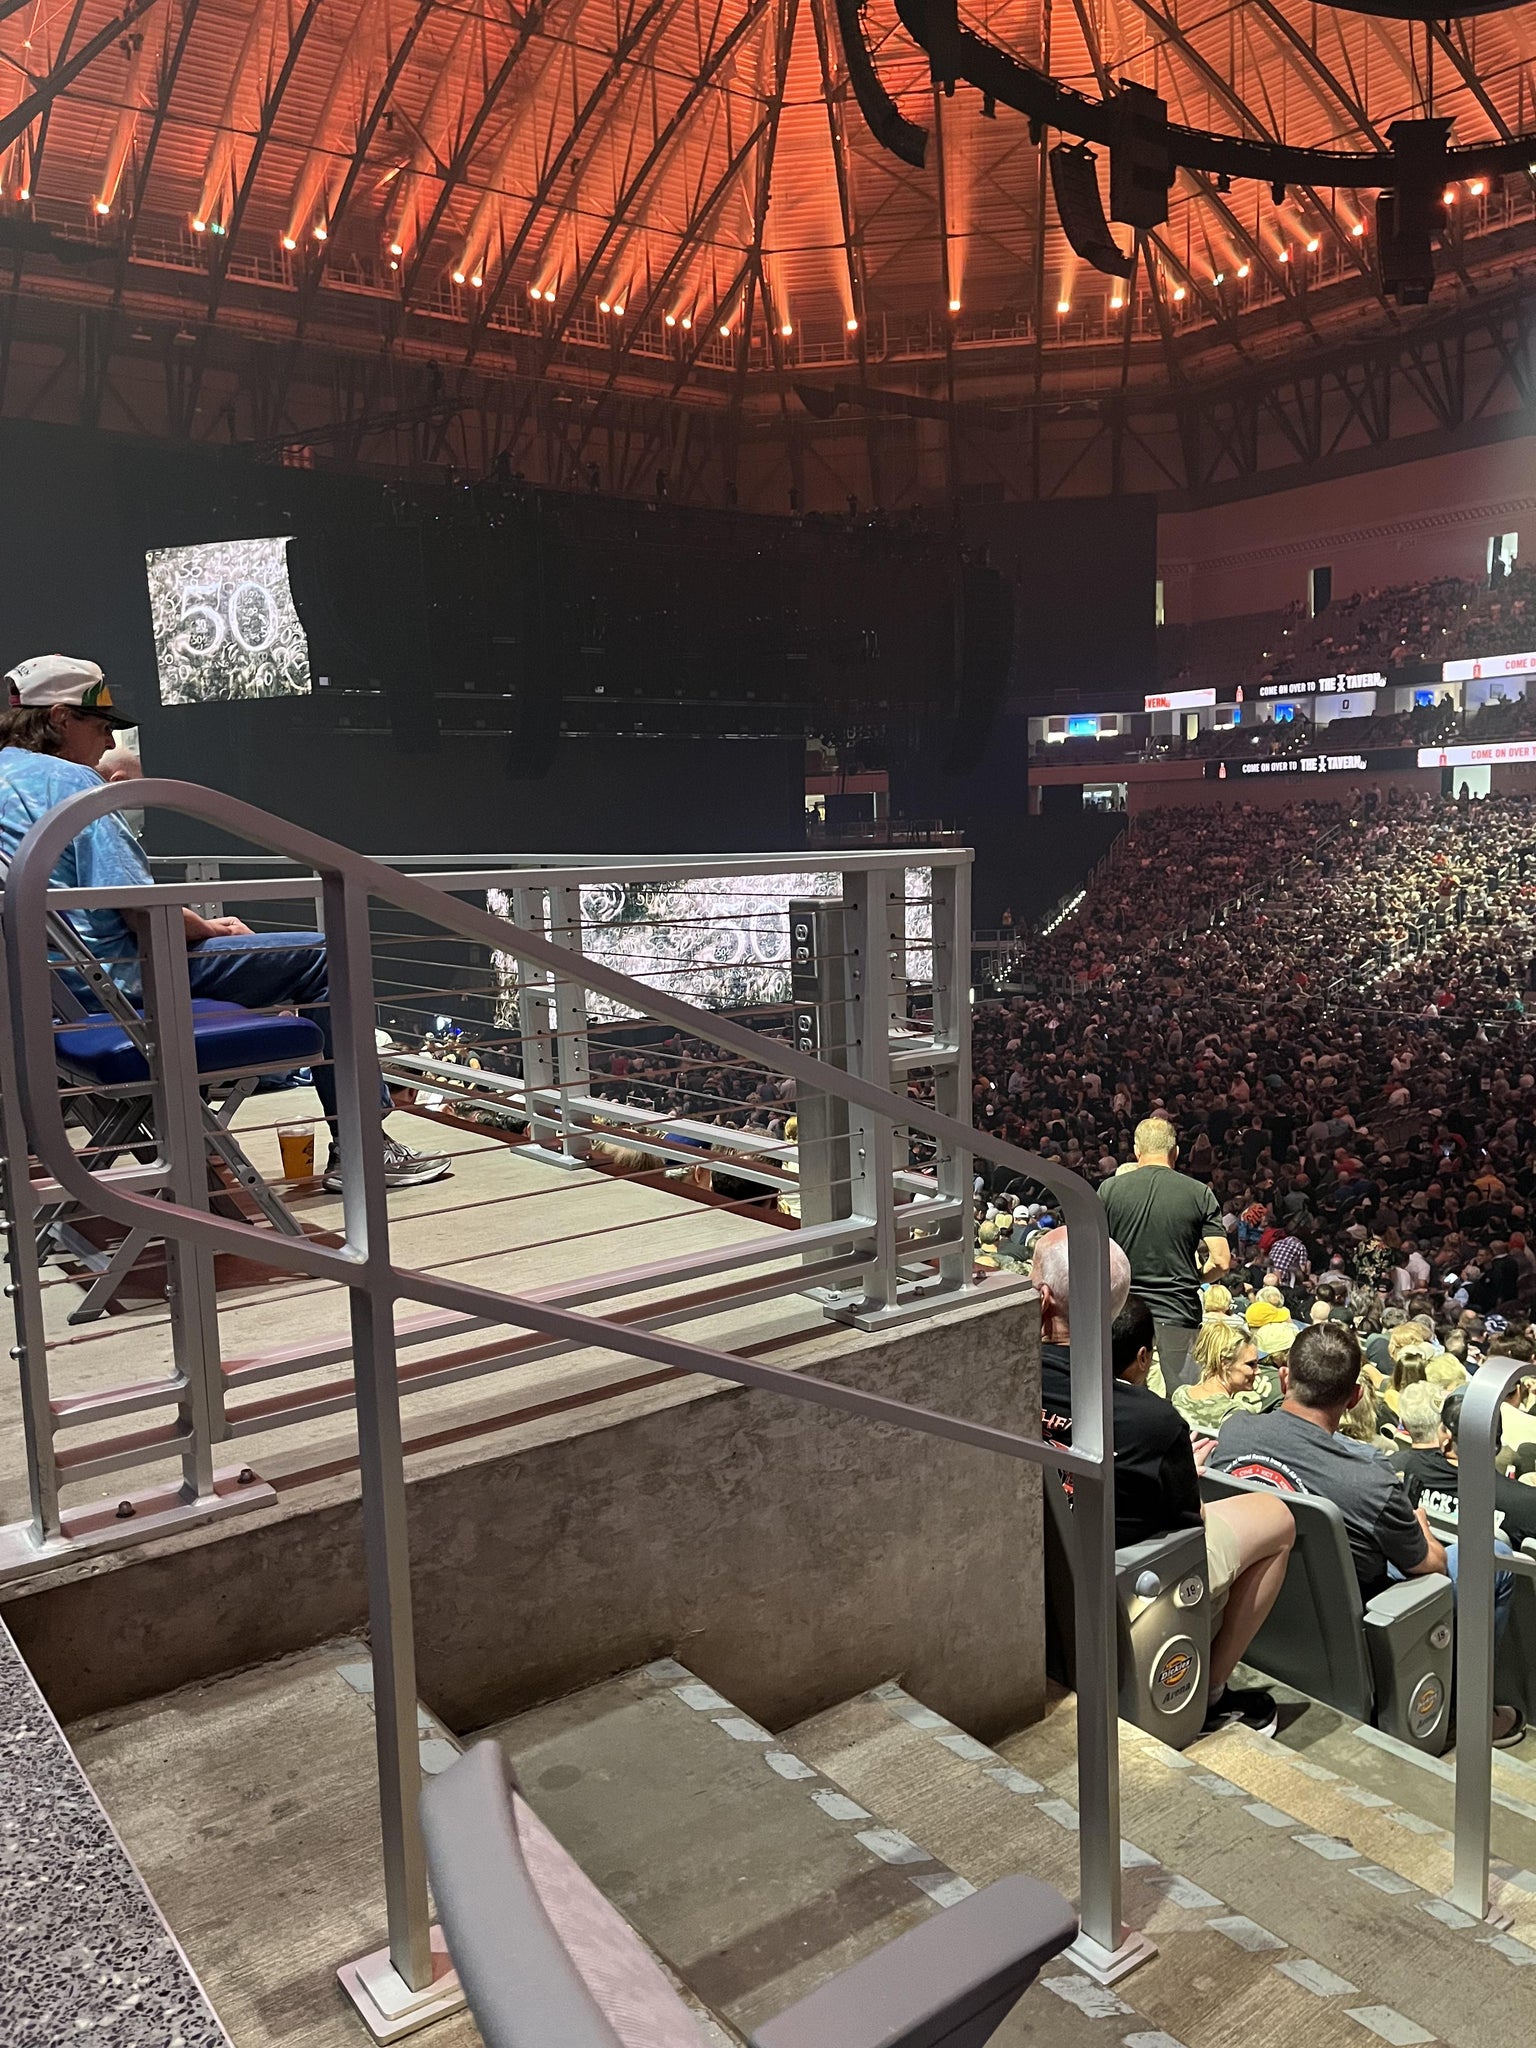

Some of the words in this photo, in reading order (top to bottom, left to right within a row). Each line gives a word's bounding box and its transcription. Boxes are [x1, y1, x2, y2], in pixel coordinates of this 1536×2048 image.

[168, 576, 278, 655] 50
[1505, 659, 1528, 669] COME
[1259, 685, 1278, 696] COME
[1278, 684, 1288, 694] ON
[1289, 682, 1306, 694] OVER
[1306, 681, 1316, 692] TO
[1318, 677, 1337, 692] THE
[1345, 672, 1381, 689] TAVERN
[1145, 697, 1166, 708] VERN
[1471, 750, 1492, 760] COME
[1495, 749, 1506, 758] ON
[1508, 747, 1530, 757] OVER
[1242, 763, 1260, 774] COME
[1260, 762, 1270, 772] ON
[1271, 761, 1288, 772] OVER
[1288, 760, 1298, 770] TO
[1300, 758, 1318, 772] THE
[1326, 755, 1362, 770] TAVERN
[1185, 1584, 1197, 1598] 19
[1160, 1659, 1191, 1681] Dickies
[1162, 1682, 1191, 1705] Arena
